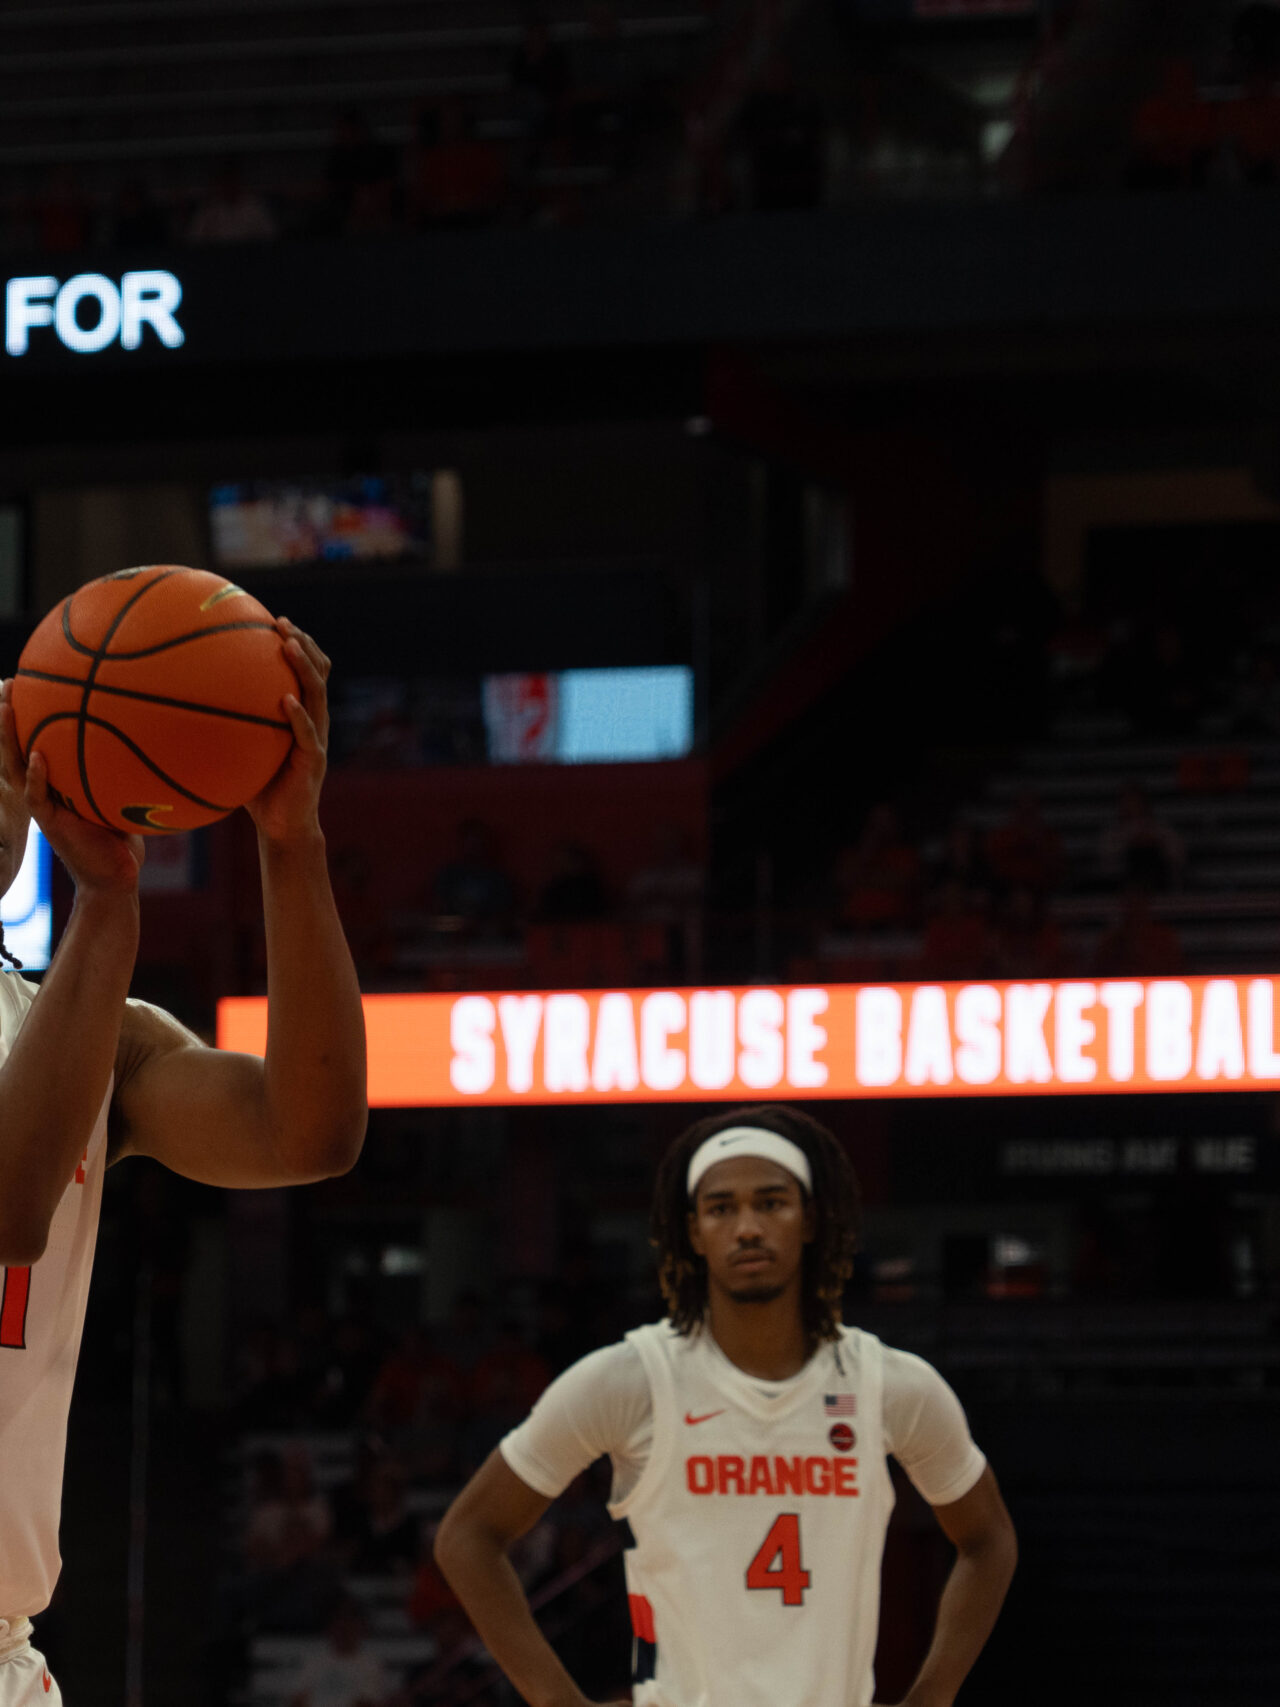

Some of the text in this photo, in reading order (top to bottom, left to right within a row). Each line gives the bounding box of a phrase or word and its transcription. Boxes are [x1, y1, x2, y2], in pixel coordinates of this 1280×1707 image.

[5, 269, 185, 357] FOR
[449, 988, 830, 1095] SYRACUSE
[686, 1455, 859, 1497] ORANGE
[746, 1513, 811, 1606] 4
